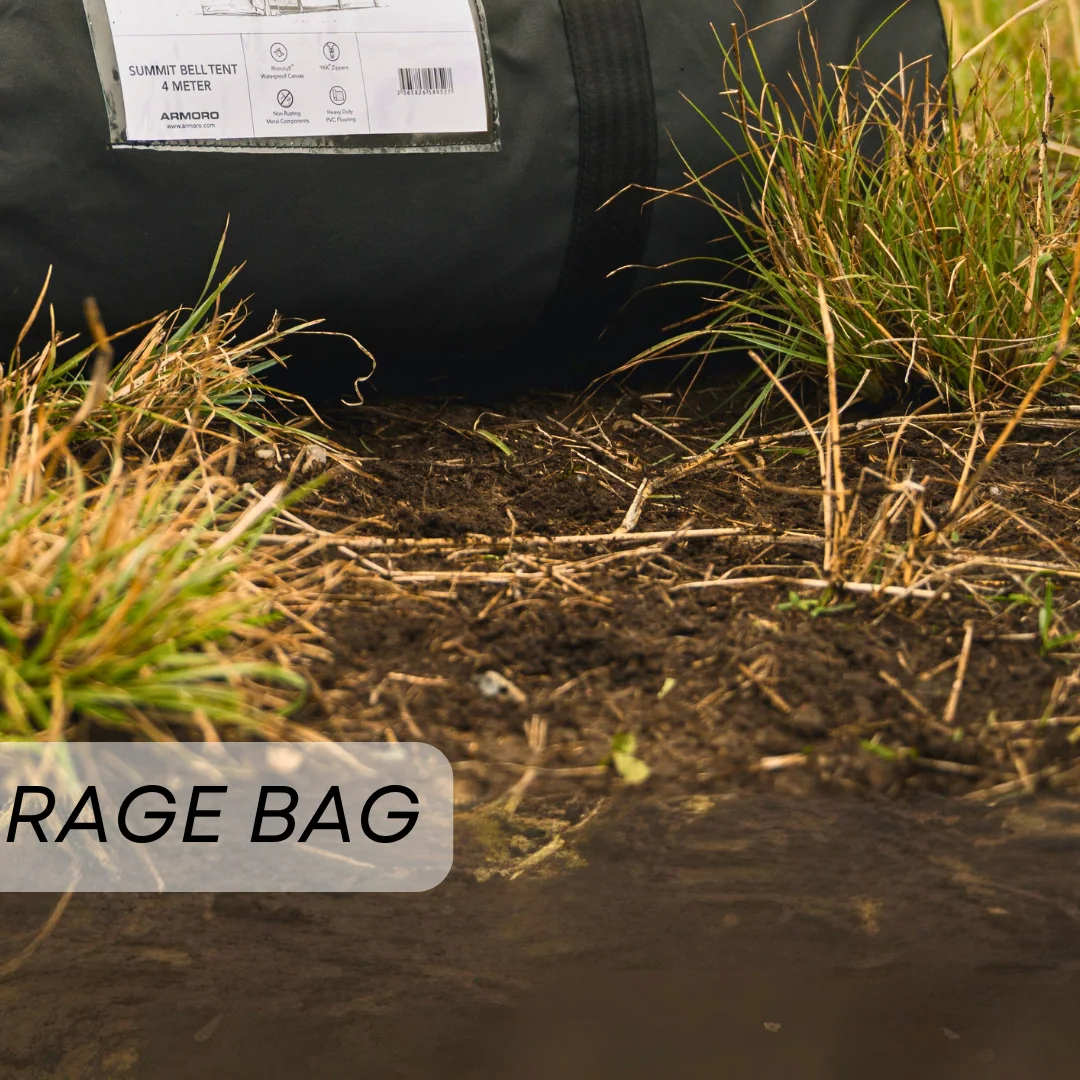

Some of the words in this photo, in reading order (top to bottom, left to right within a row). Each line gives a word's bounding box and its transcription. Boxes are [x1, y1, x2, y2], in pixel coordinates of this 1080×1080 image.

[128, 65, 176, 76] SUMMIT
[180, 64, 207, 75] BELL
[208, 64, 238, 75] TENT
[161, 81, 169, 91] 4
[172, 80, 212, 91] METER
[160, 111, 220, 121] ARMORO
[283, 110, 301, 118] Rusting
